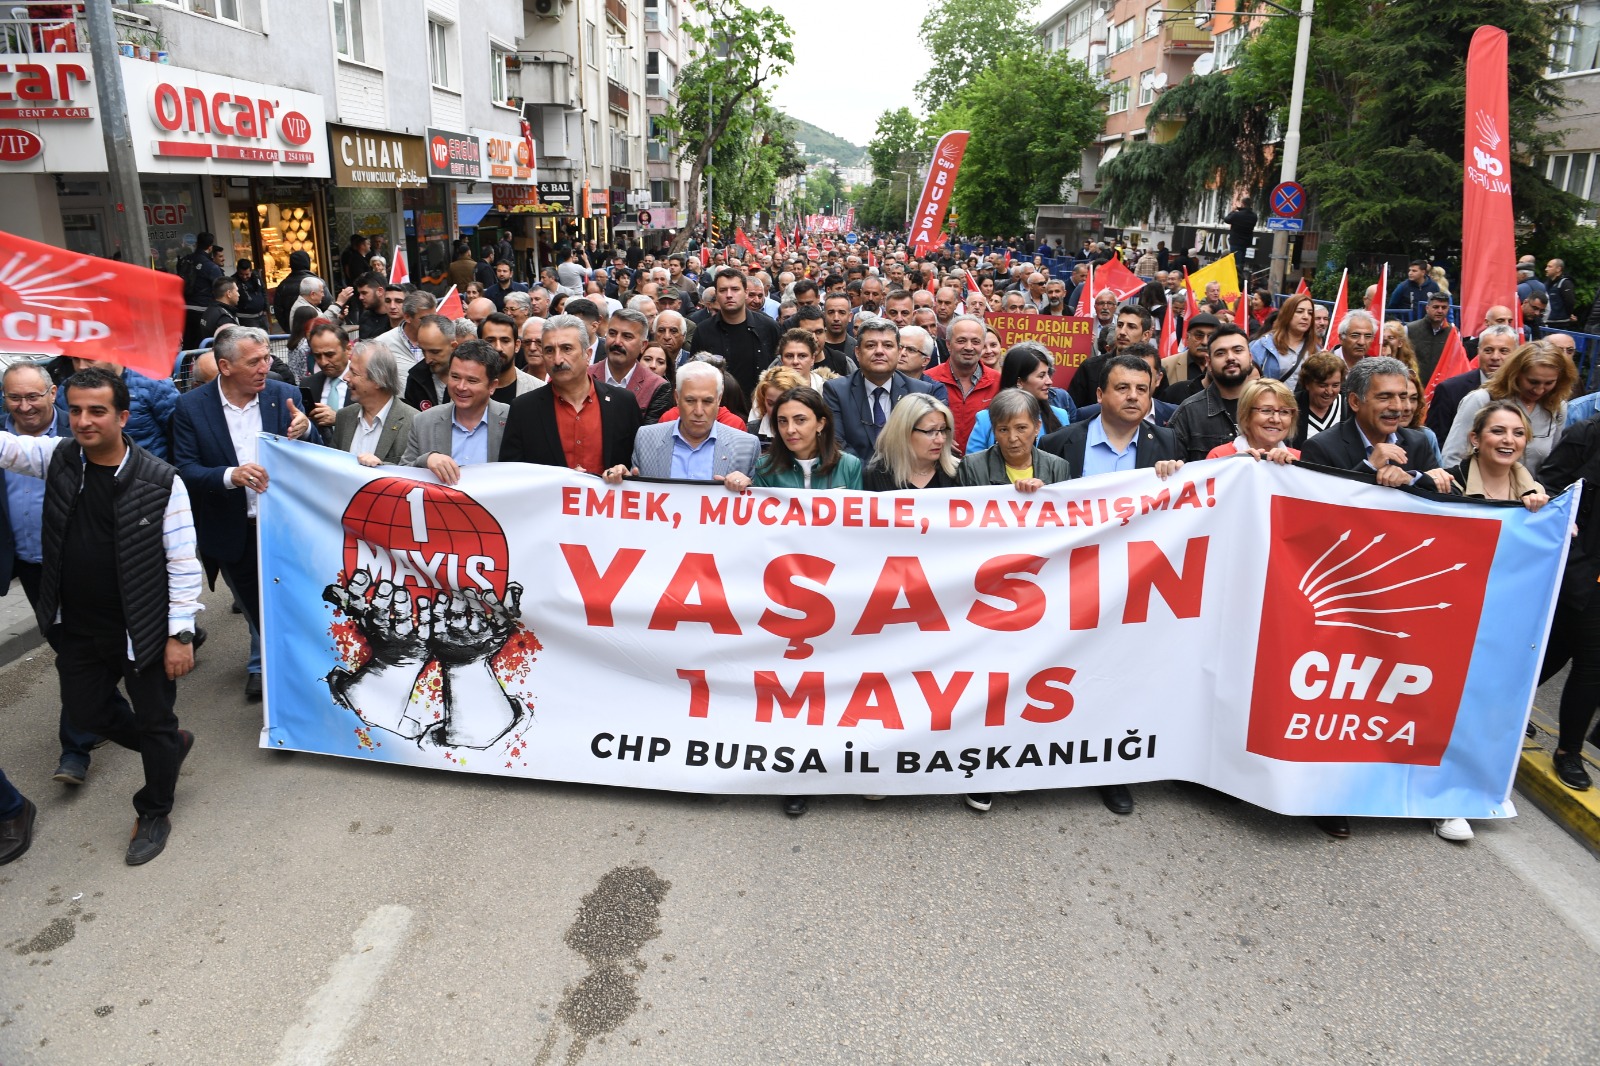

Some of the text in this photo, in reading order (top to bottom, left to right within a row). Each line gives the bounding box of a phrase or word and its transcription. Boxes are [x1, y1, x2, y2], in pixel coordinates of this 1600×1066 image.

[18, 109, 46, 117] RENT
[52, 109, 60, 117] A
[154, 83, 274, 139] oncar
[286, 117, 307, 138] VIP
[259, 151, 265, 160] A
[266, 151, 279, 160] CAR
[341, 130, 404, 169] CİHAN
[432, 143, 448, 161] VIP
[937, 158, 955, 169] CHP
[351, 170, 395, 183] KUYUMCULUK
[541, 183, 570, 192] & BAL
[143, 204, 187, 226] ncar
[915, 170, 948, 243] BURSA
[2, 311, 111, 343] CHP
[987, 315, 1089, 335] VERGİ DEDİLER
[406, 487, 429, 543] 1
[561, 477, 1217, 534] EMEK, MÜCADELE, DAYANIŞMA!
[356, 538, 495, 592] MAYIS
[558, 535, 1210, 660] YAŞASIN
[1289, 650, 1433, 704] CHP
[676, 666, 1077, 731] 1 MAYIS
[1283, 713, 1416, 746] BURSA
[590, 728, 1157, 779] CHP BURSA İL BAŞKANLIĞI
